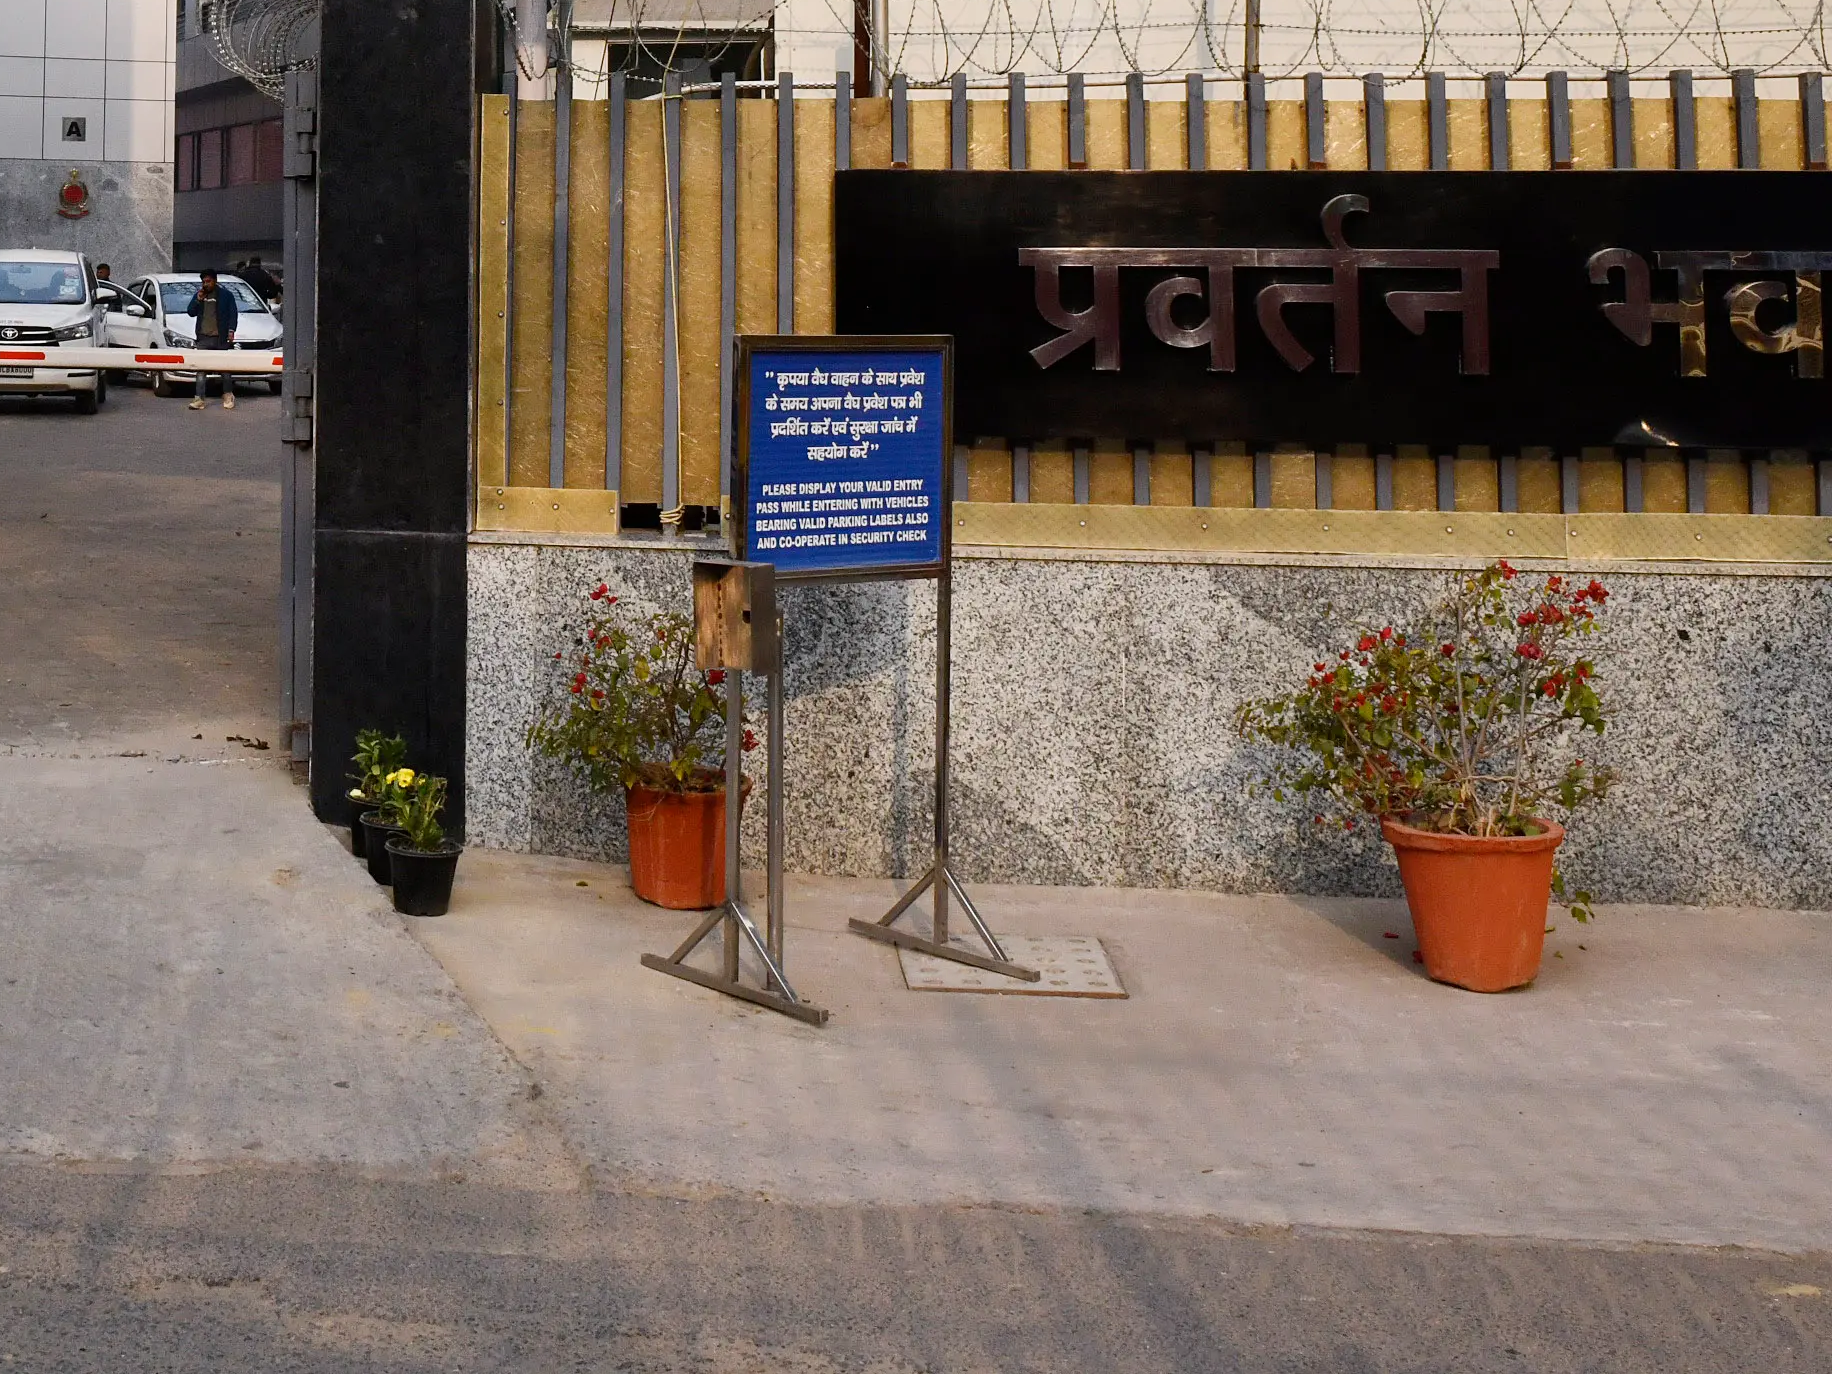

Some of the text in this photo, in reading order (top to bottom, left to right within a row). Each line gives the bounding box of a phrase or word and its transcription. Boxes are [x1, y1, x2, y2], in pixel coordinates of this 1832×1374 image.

[66, 122, 82, 137] A
[1018, 193, 1500, 375] प्रवर्तन
[776, 372, 809, 391] कृपया
[830, 372, 860, 386] वाहन
[861, 368, 874, 385] के
[876, 372, 898, 385] साथ
[899, 368, 925, 387] प्रवेश
[765, 393, 778, 411] के
[780, 397, 809, 411] समय
[810, 397, 843, 411] अपना
[863, 392, 888, 412] प्रवेश
[890, 396, 907, 410] पत्र
[908, 391, 923, 409] भी
[770, 416, 918, 441] प्रदर्शित करें एवं सुरक्षा जांच में
[807, 442, 847, 461] सहयोग
[762, 479, 924, 496] PLEASE DISPLAY YOUR VALID ENTRY
[756, 495, 929, 515] PASS WHILE ENTERING WITH VEHICLES
[755, 512, 929, 532] BEARING VALID PARKING LABELS ALSO
[757, 530, 927, 550] AND CO-OPERATE IN SECURITY CHECK
